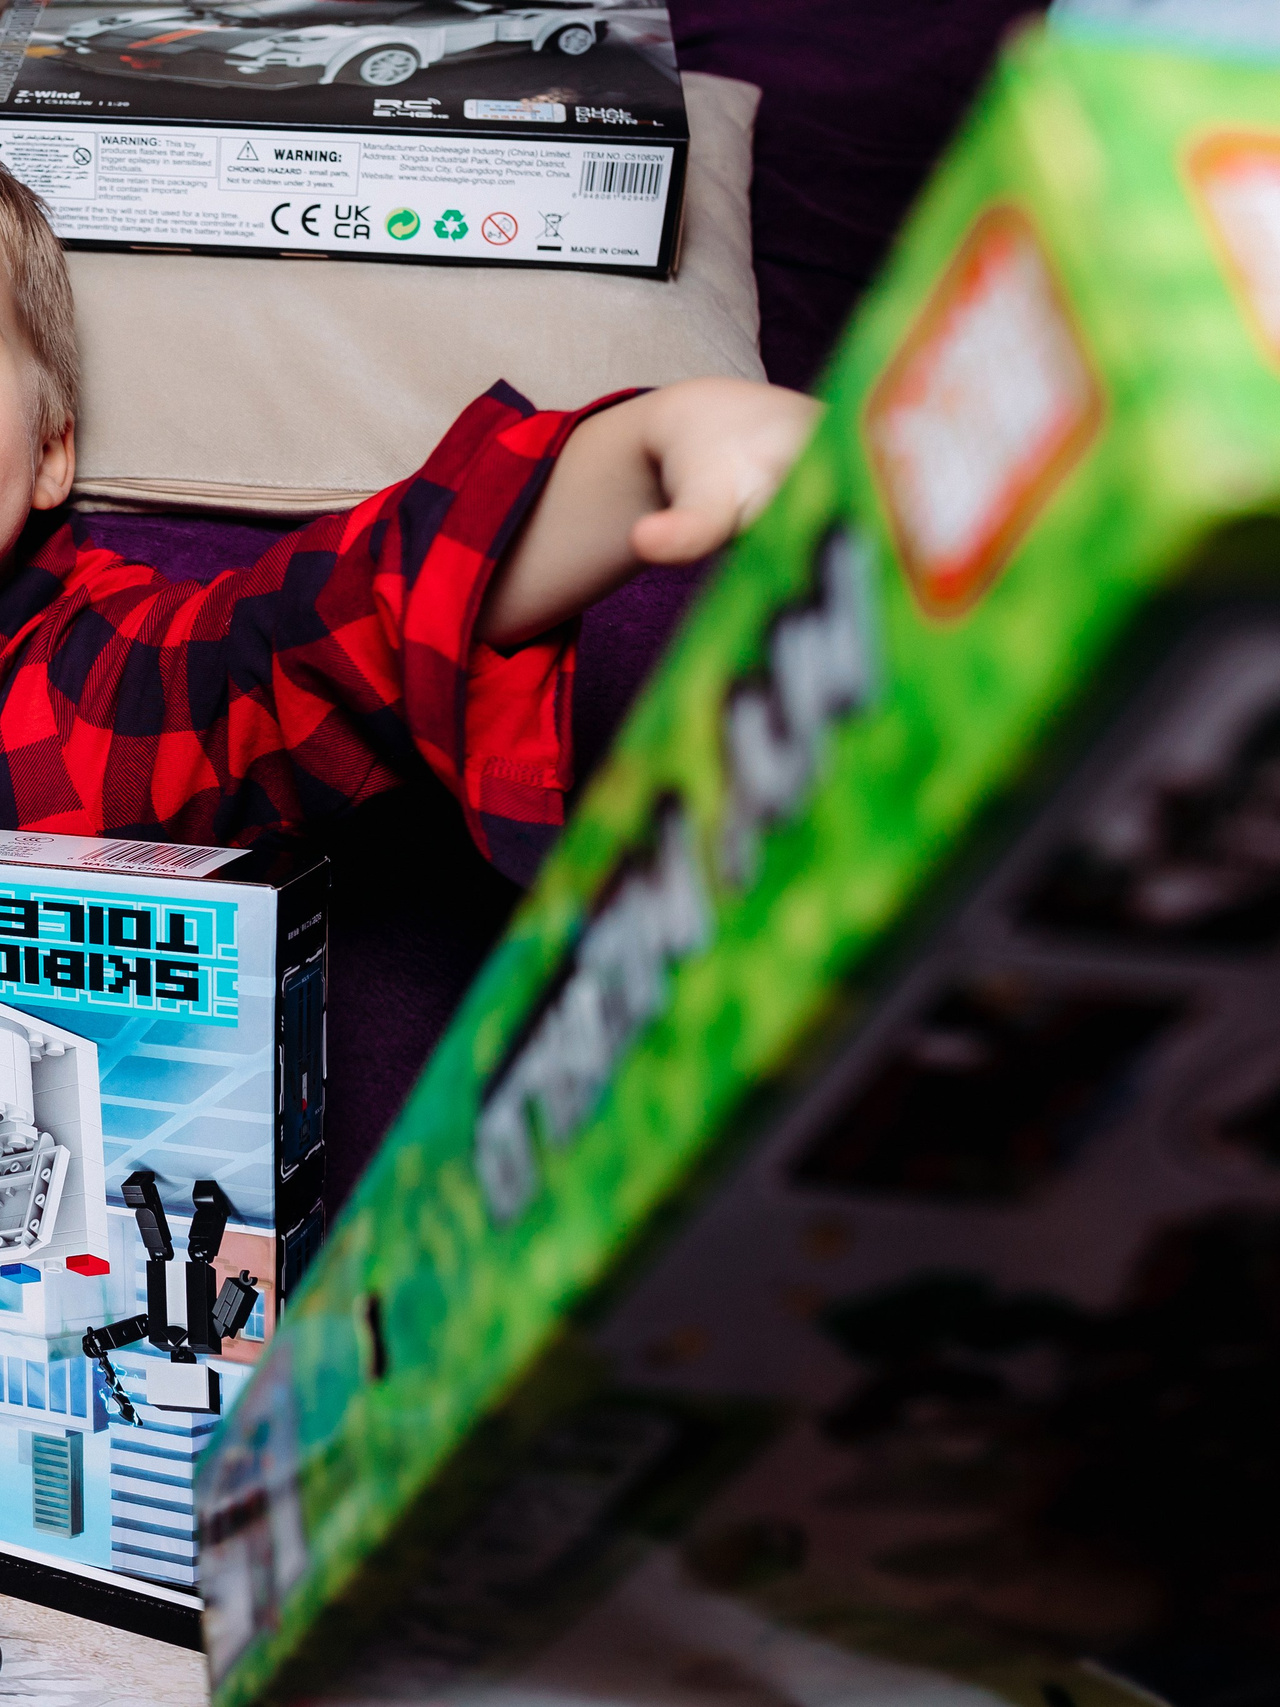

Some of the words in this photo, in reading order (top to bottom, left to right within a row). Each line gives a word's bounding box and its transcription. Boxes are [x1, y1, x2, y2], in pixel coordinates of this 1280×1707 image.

[16, 90, 81, 99] Z-Wind
[101, 136, 162, 146] WARNING:
[166, 140, 182, 148] This
[184, 141, 197, 150] toy
[273, 148, 342, 163] WARNING:
[472, 147, 505, 158] Industry
[507, 148, 538, 159] (China)
[583, 151, 605, 159] ITEM
[227, 165, 265, 173] CHOKING
[267, 166, 302, 175] HAZARD
[455, 166, 503, 177] Guangdong
[227, 176, 239, 184] Not
[241, 176, 251, 184] for
[253, 177, 281, 185] children
[571, 246, 597, 254] MADE
[610, 247, 640, 256] CHINA
[82, 861, 119, 869] MADE
[137, 865, 177, 874] CHINA
